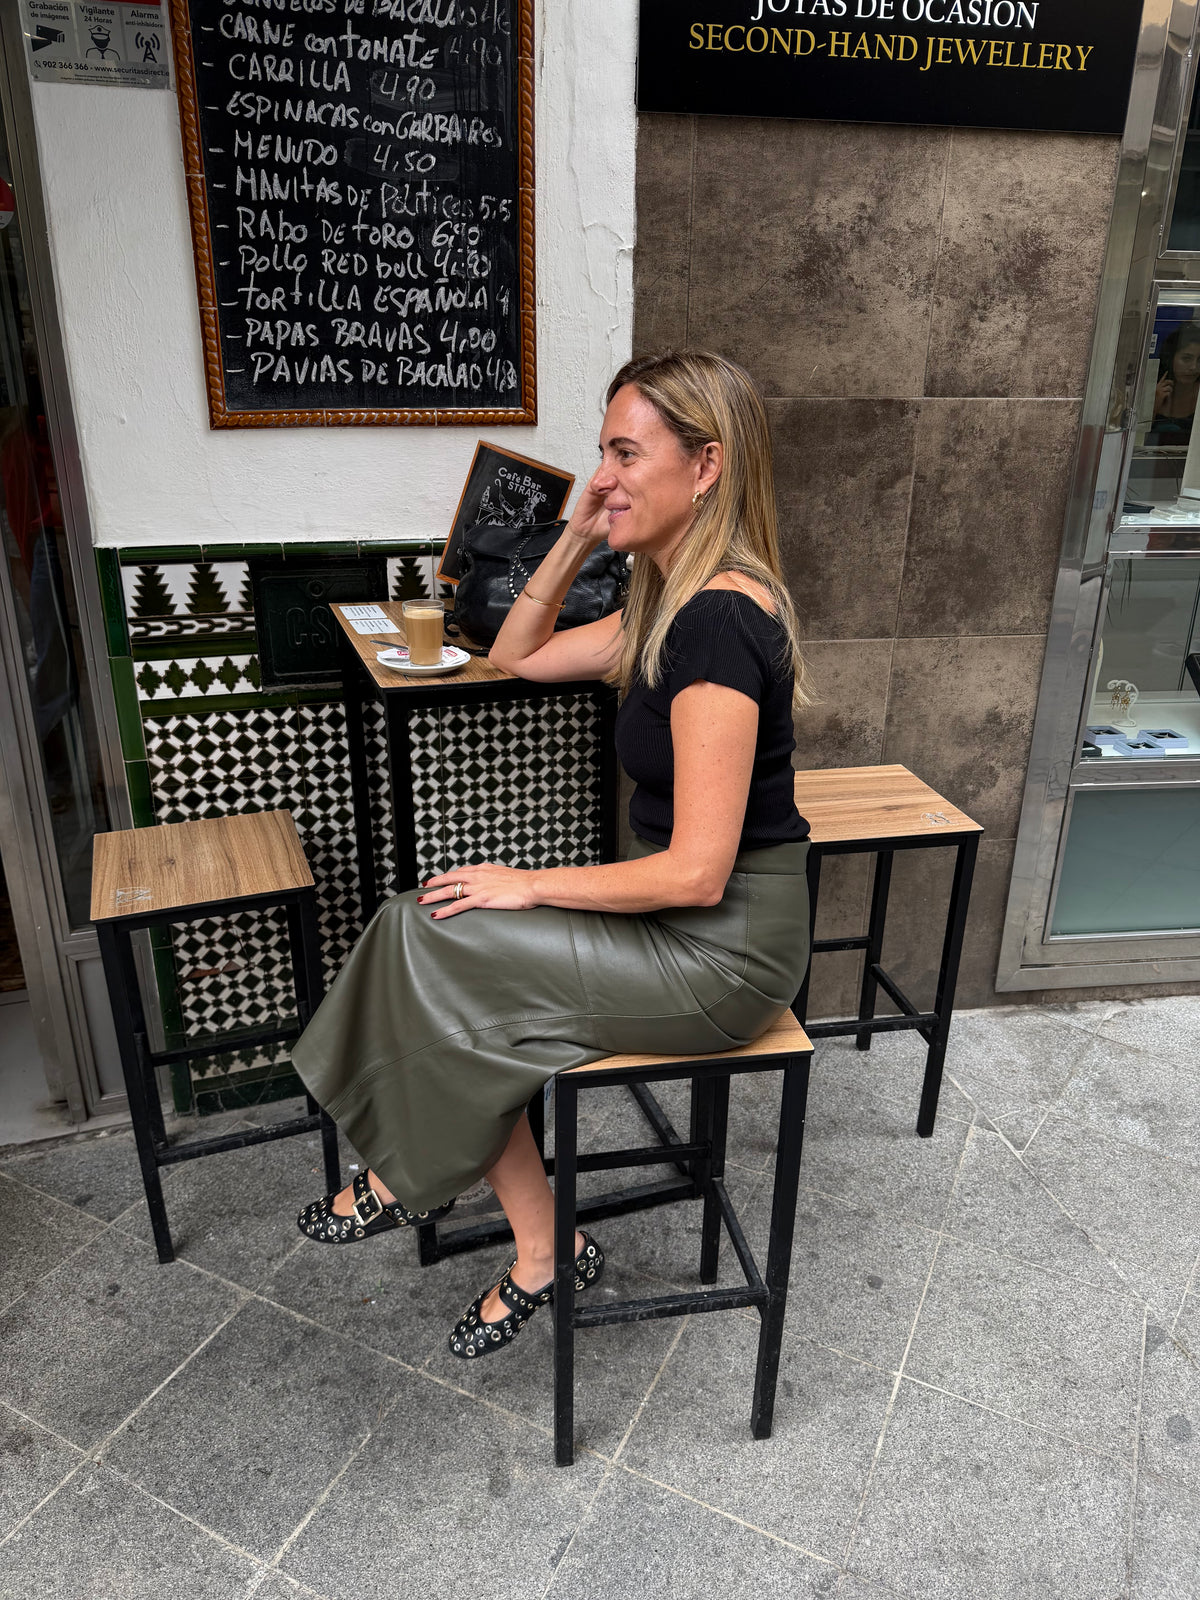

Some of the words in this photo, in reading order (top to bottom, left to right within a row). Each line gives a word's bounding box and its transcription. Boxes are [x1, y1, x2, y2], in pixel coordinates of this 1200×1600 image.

[29, 1, 69, 12] Grabación
[40, 12, 70, 21] imágenes
[79, 5, 115, 16] Vigilante
[130, 9, 160, 20] Alarma
[854, 0, 896, 20] DE
[94, 16, 112, 24] Horas
[125, 20, 165, 28] anti-inhibidore
[220, 12, 296, 47] CARNE
[689, 22, 918, 62] SECOND-HAND
[919, 36, 1094, 72] JEWELLERY
[42, 61, 57, 69] 902
[58, 62, 73, 71] 366
[74, 63, 89, 71] 366
[94, 65, 170, 77] www.securitasdirect.e
[226, 91, 360, 129] ESPINACAS
[234, 130, 338, 166] MENUDO
[373, 144, 437, 174] 4,50
[347, 184, 373, 211] DE
[321, 218, 346, 246] DE
[321, 248, 368, 277] RED
[246, 317, 320, 350] PAPAS
[331, 317, 431, 354] BRAVAS
[251, 352, 355, 386] PAVIAS
[361, 358, 389, 386] DE
[498, 466, 522, 482] Café
[522, 475, 541, 491] Bar
[507, 480, 548, 503] STRATOS
